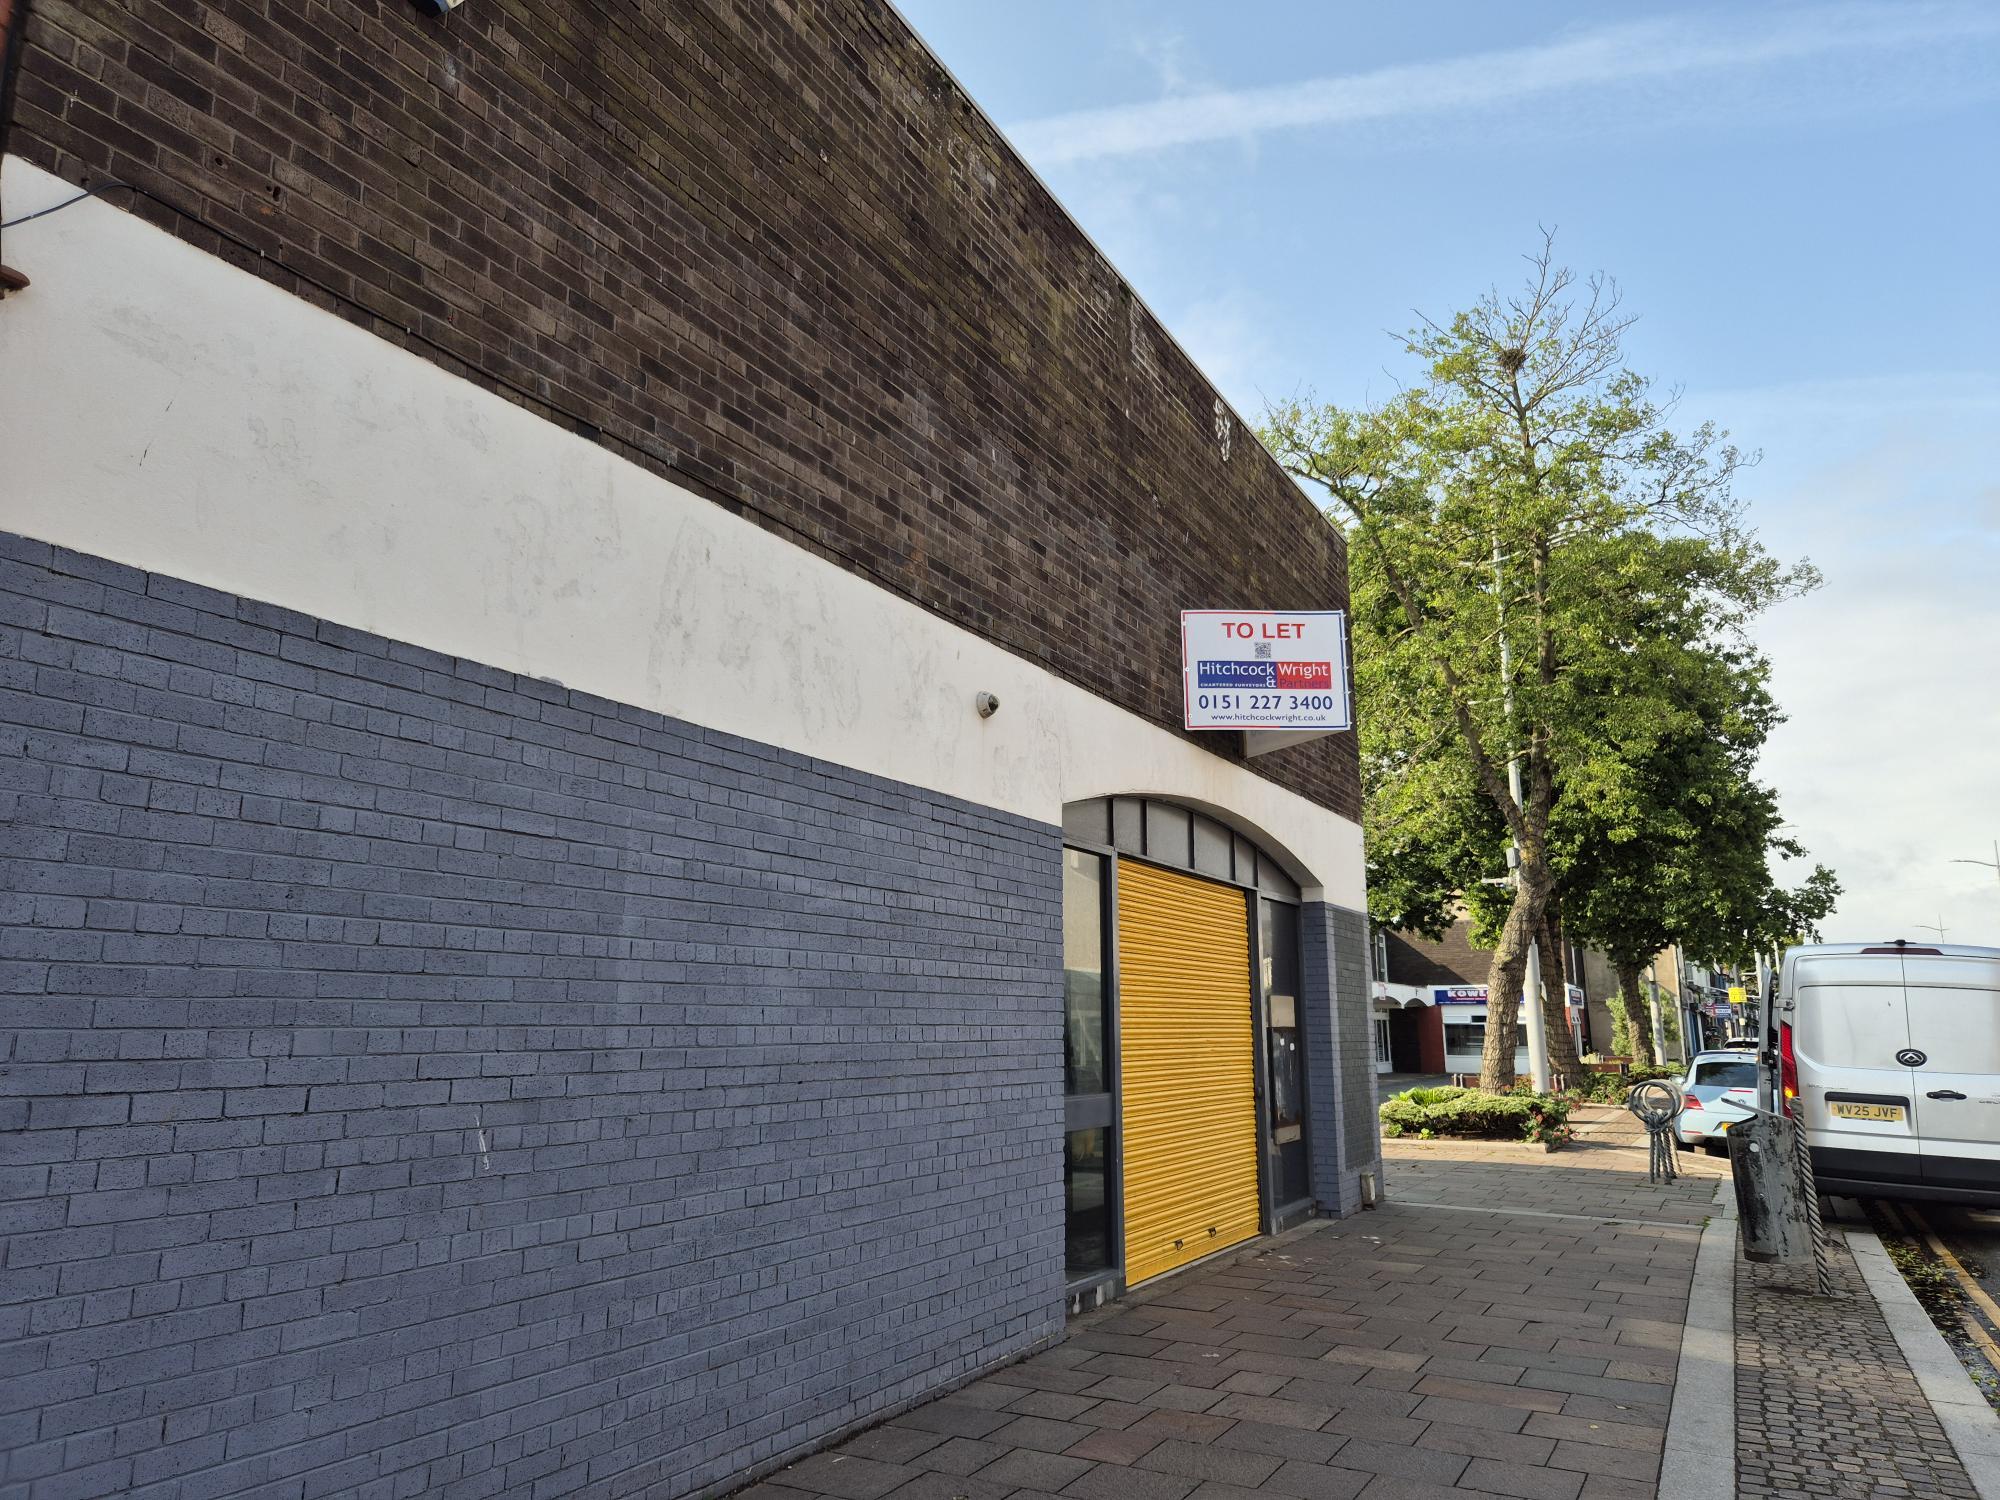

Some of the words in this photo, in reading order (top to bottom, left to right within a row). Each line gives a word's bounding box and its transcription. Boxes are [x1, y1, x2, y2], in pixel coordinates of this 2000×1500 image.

[1221, 622, 1255, 639] TO
[1262, 623, 1306, 639] LET
[1200, 662, 1275, 676] Hitchcock
[1278, 663, 1329, 679] Wright
[1266, 676, 1277, 688] &
[1279, 679, 1329, 688] Partners
[1199, 695, 1240, 710] 0151
[1249, 695, 1282, 710] 227
[1289, 695, 1333, 710] 3400
[1211, 713, 1326, 722] www.hitchcockwright.co.uk
[1837, 1104, 1870, 1116] WV25
[1873, 1106, 1897, 1118] JVF
